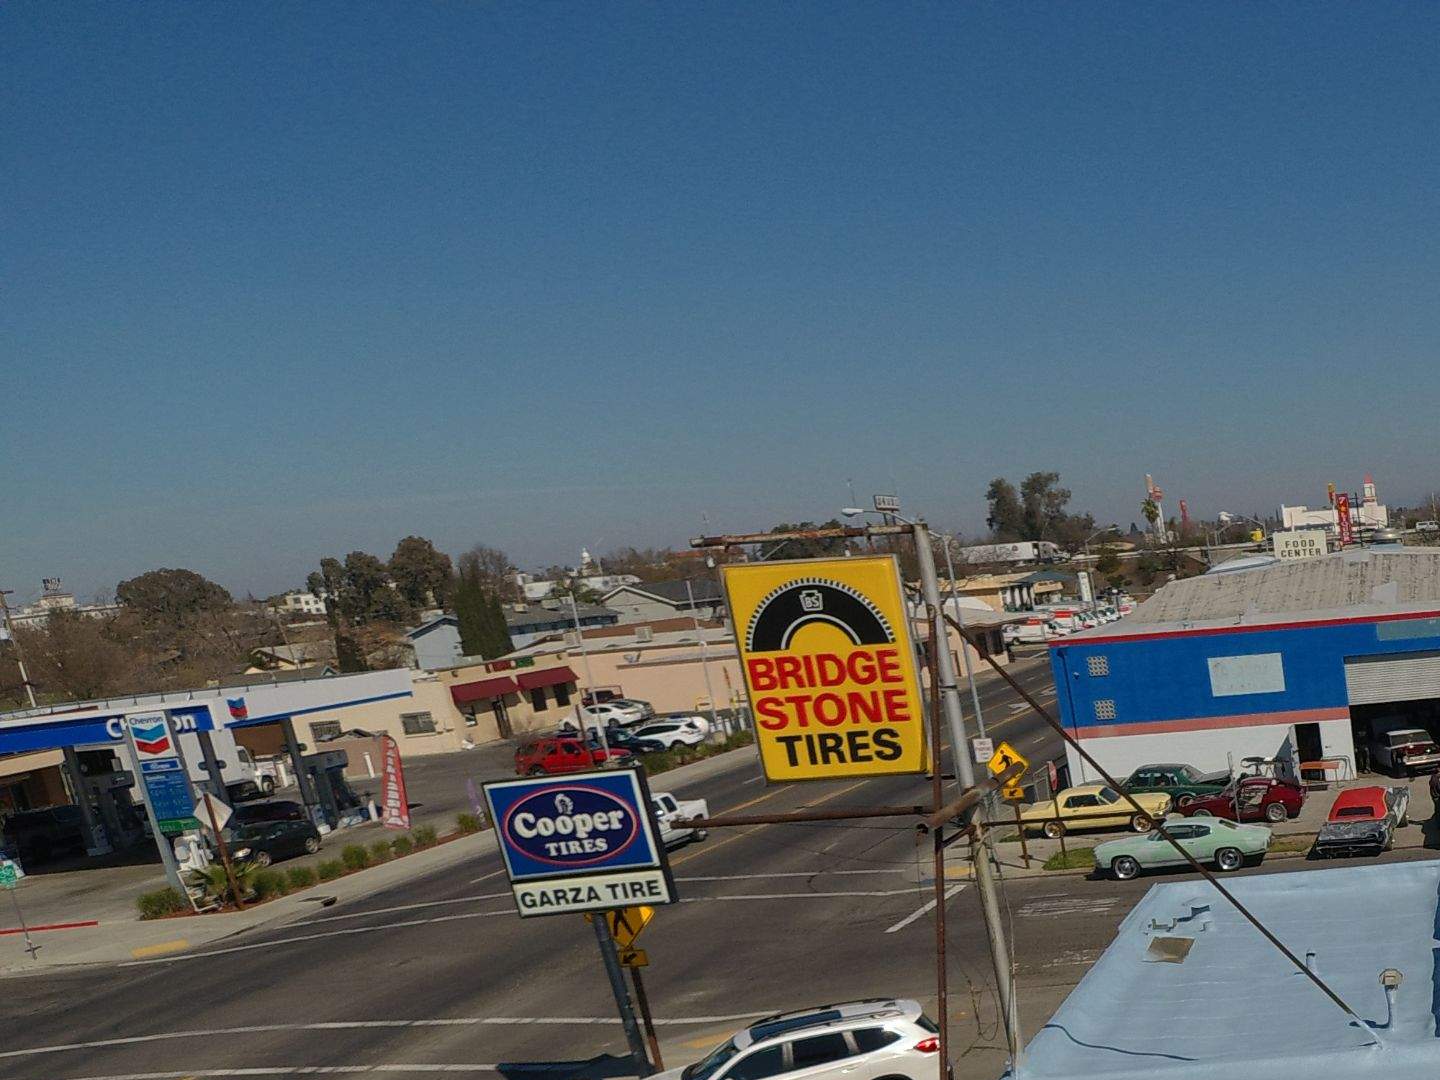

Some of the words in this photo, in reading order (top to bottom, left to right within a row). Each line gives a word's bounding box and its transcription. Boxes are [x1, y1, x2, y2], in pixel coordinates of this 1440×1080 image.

[1281, 548, 1321, 557] CENTER
[1285, 540, 1314, 548] FOOD
[804, 596, 820, 608] BS
[747, 649, 904, 692] BRIDGE
[756, 689, 911, 731] STONE
[776, 728, 903, 767] TIRES
[514, 810, 624, 839] Cooper
[545, 838, 608, 857] TIRES
[520, 886, 602, 908] GARZA
[606, 879, 662, 900] TIRE
